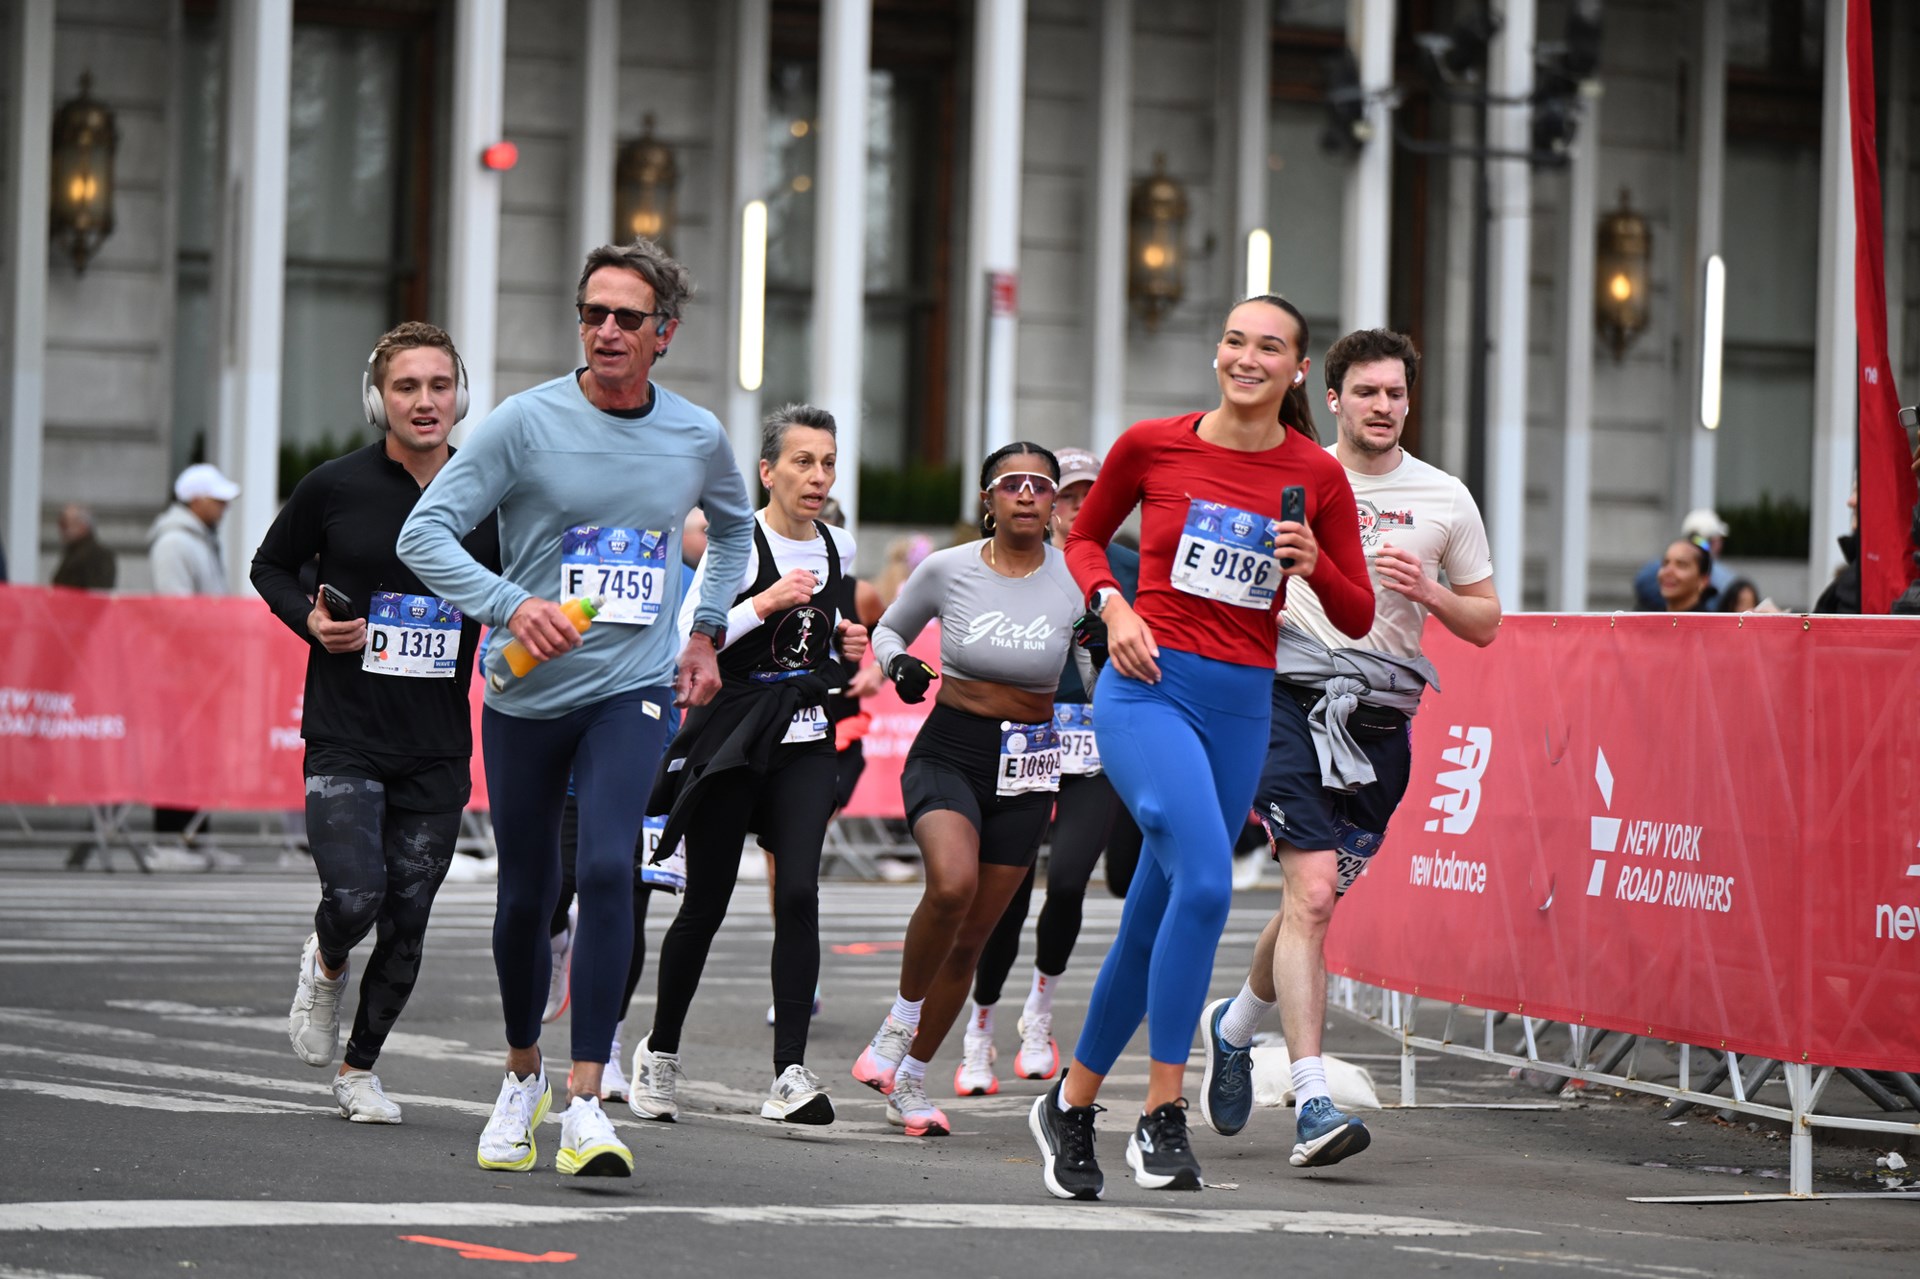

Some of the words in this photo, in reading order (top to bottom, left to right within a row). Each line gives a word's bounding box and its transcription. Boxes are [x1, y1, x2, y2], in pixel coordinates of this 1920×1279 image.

[1184, 542, 1205, 569] E
[1211, 548, 1271, 586] 9186
[569, 570, 584, 594] F
[598, 569, 653, 601] 7459
[371, 630, 388, 653] D
[398, 631, 446, 659] 1313
[962, 611, 1056, 645] Girls
[990, 636, 1021, 649] THAT
[1023, 640, 1046, 651] RUN
[38, 714, 126, 740] RUNNERS
[1061, 734, 1093, 756] 975
[1622, 819, 1664, 857] NEW
[1662, 823, 1703, 862] YORK
[1409, 854, 1431, 886] new
[1433, 849, 1487, 894] balance
[1615, 865, 1661, 904] ROAD
[1663, 872, 1735, 913] RUNNERS
[1876, 904, 1920, 941] ne
